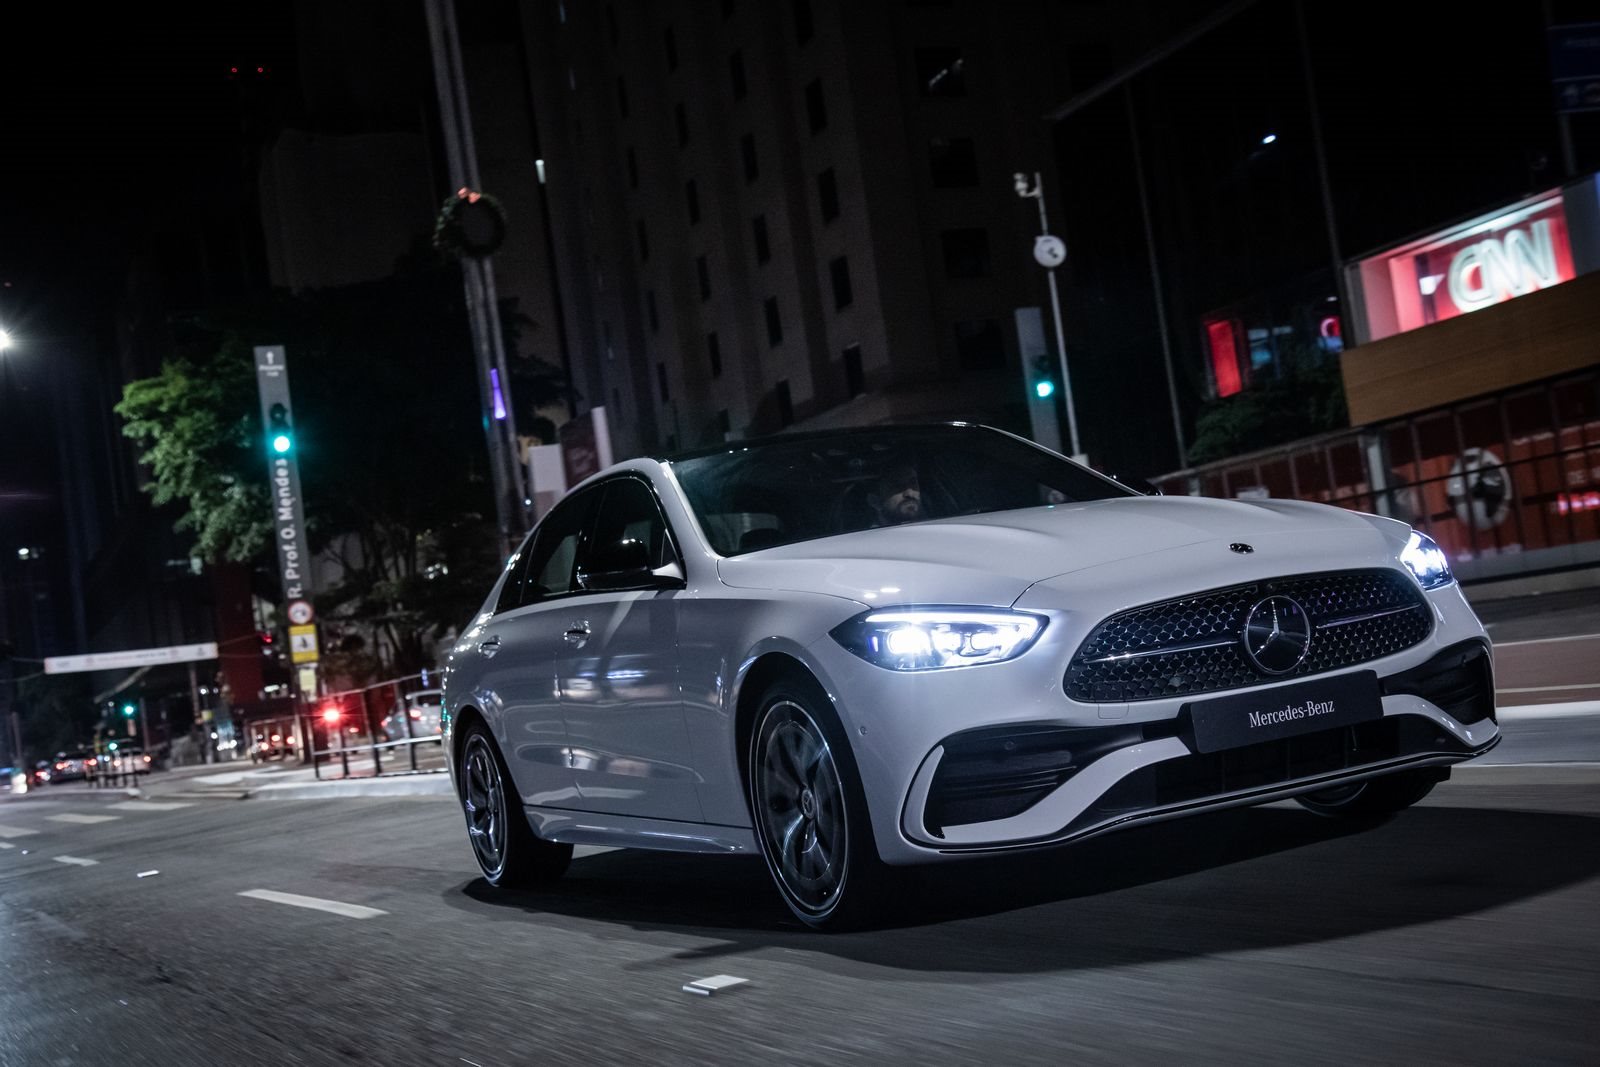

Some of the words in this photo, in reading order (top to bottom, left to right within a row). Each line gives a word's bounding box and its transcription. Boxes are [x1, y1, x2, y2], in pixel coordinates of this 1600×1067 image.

[1448, 219, 1557, 313] CNN
[280, 524, 296, 540] O.
[282, 541, 301, 580] Prof.
[287, 583, 303, 599] R.
[1248, 700, 1335, 728] Mercedes-Benz
